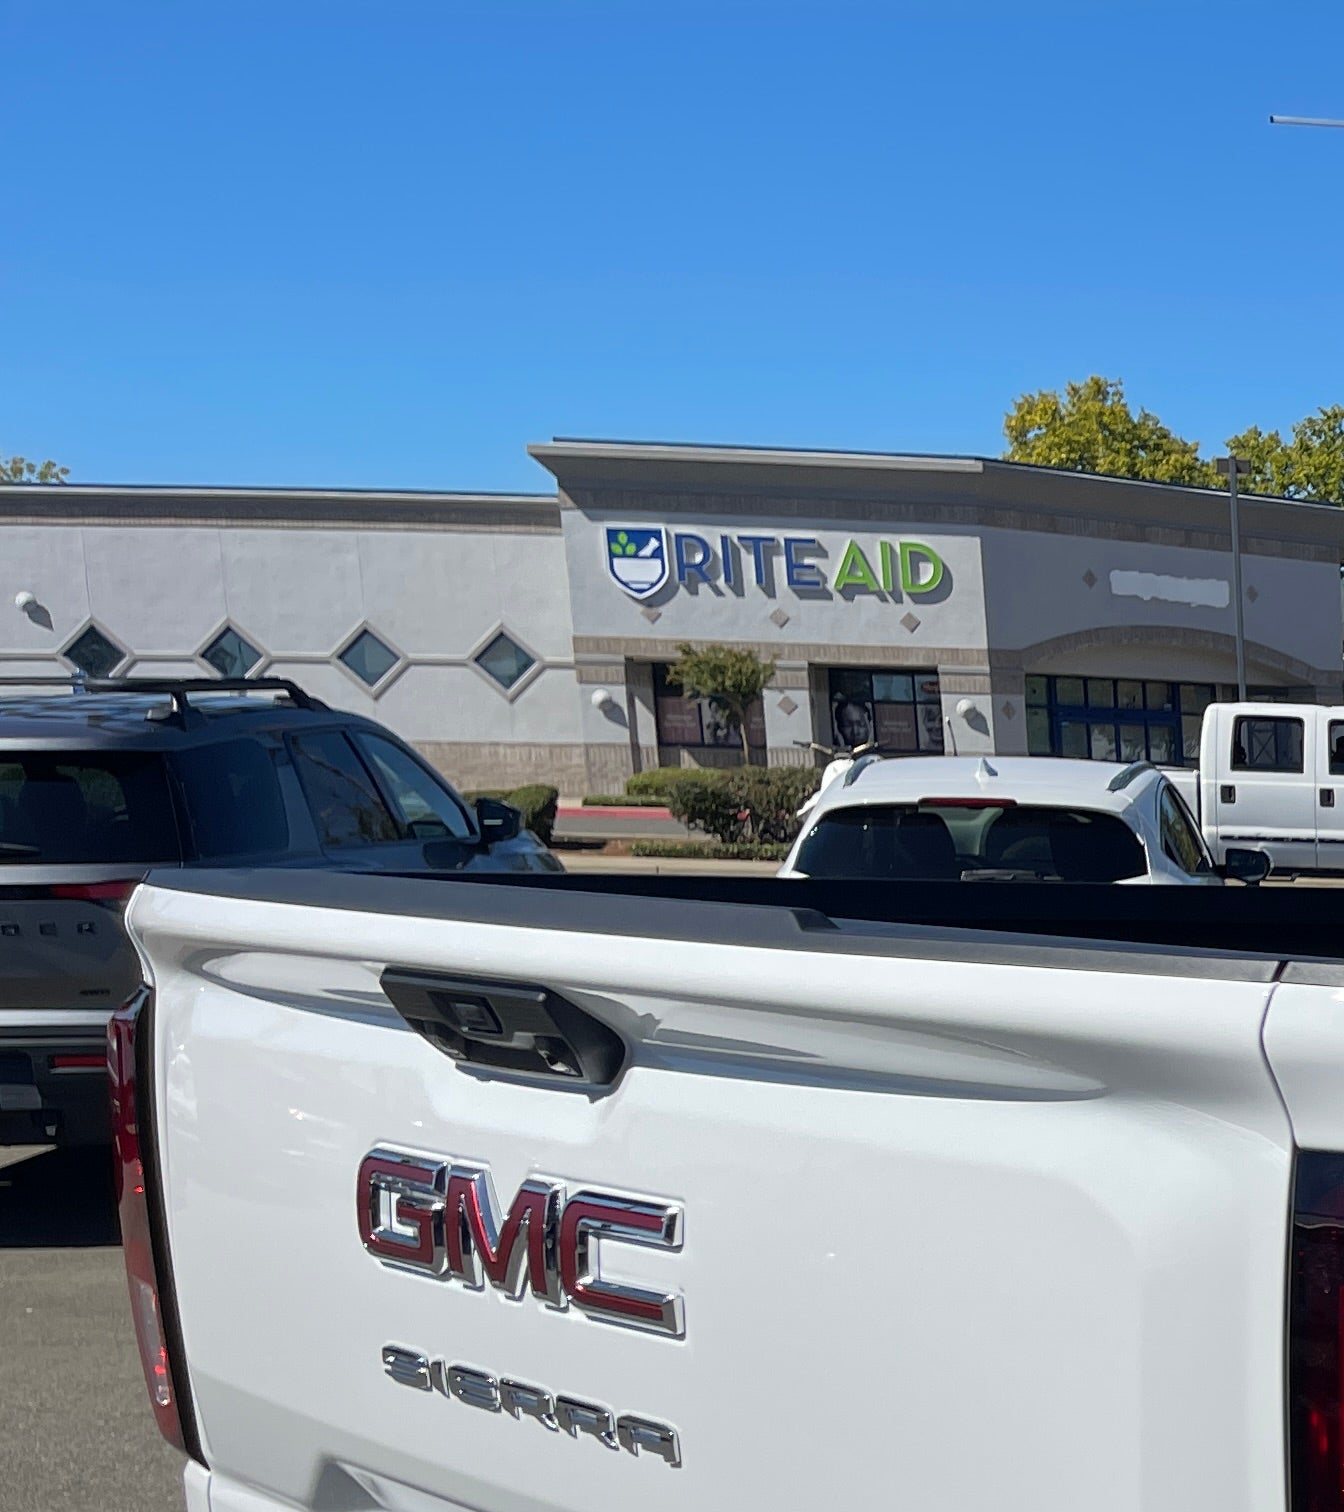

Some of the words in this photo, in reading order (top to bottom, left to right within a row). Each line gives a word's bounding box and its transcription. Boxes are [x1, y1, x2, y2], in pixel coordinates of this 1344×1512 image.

[673, 532, 822, 588] RITE
[833, 538, 945, 595] AID
[357, 1142, 687, 1340] GMC
[381, 1344, 683, 1469] SIERRA
